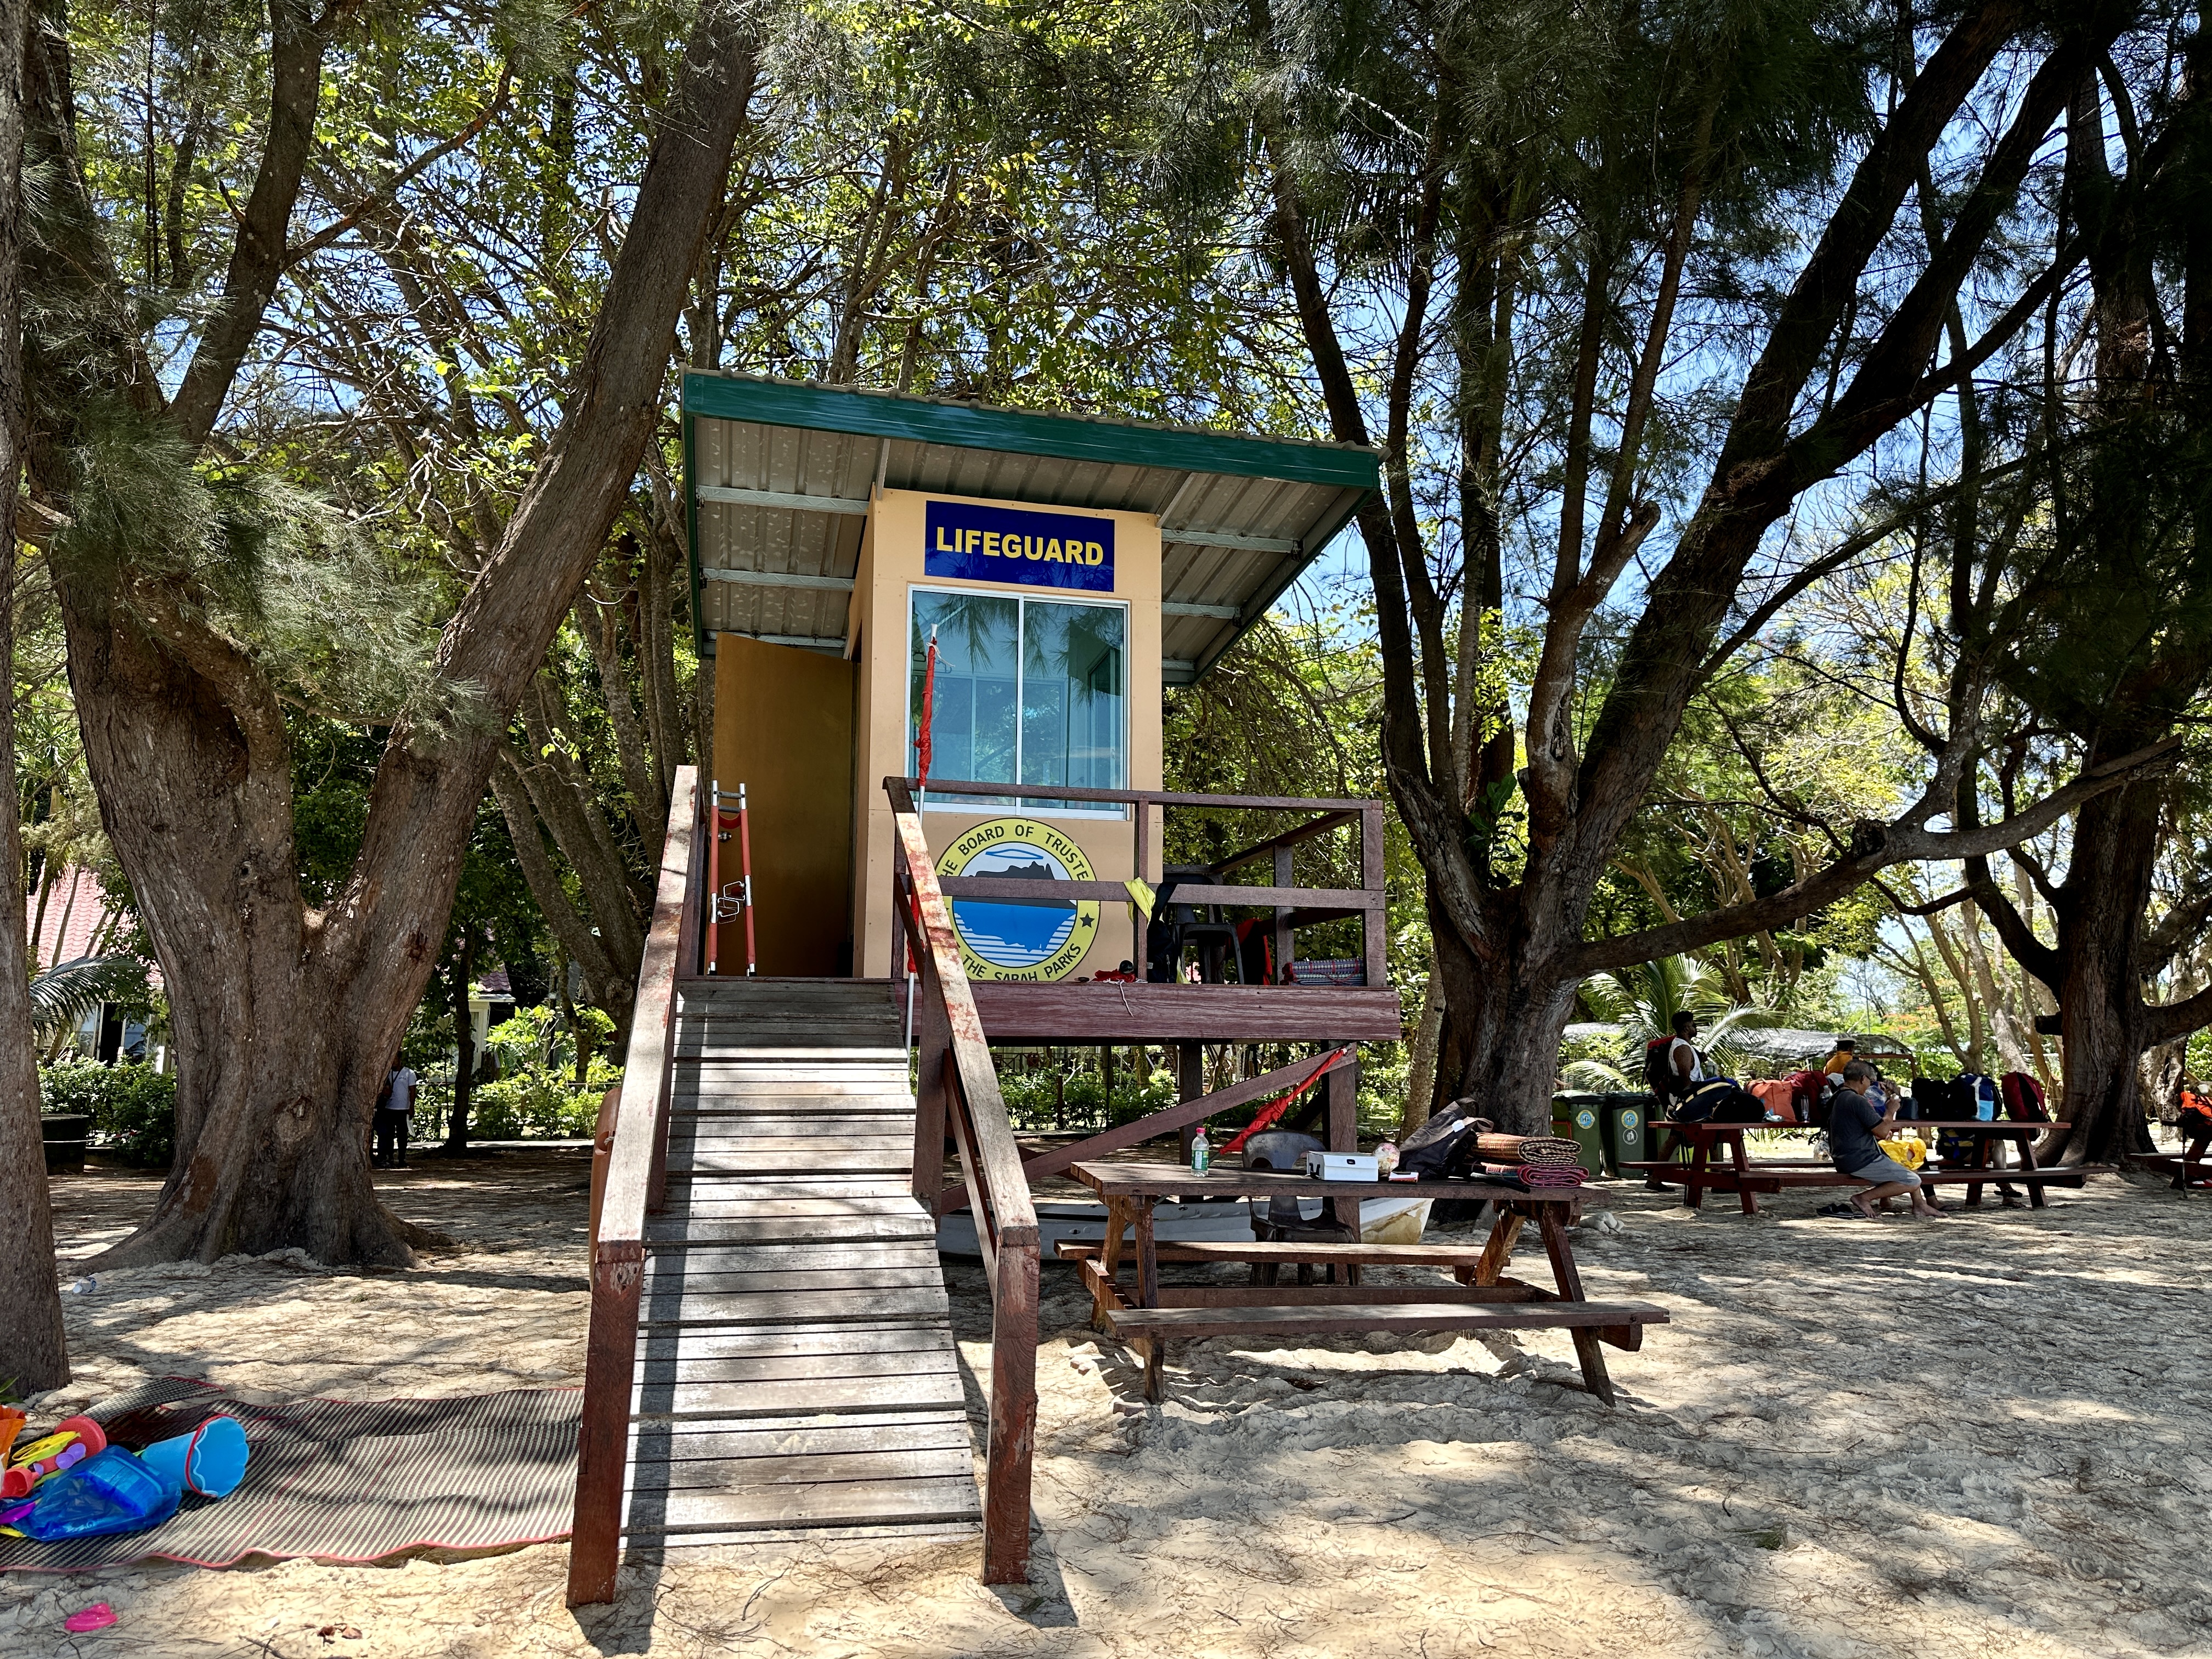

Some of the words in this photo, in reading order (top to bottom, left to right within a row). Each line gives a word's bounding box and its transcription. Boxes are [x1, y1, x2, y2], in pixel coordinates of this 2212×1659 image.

[936, 527, 1104, 566] LIFEGUARD
[940, 859, 958, 877] HE
[957, 826, 1005, 856] BOARD
[1015, 825, 1034, 837] OF
[1045, 832, 1089, 881] TRUSTE
[963, 953, 987, 978] THE
[1043, 943, 1081, 978] PARKS
